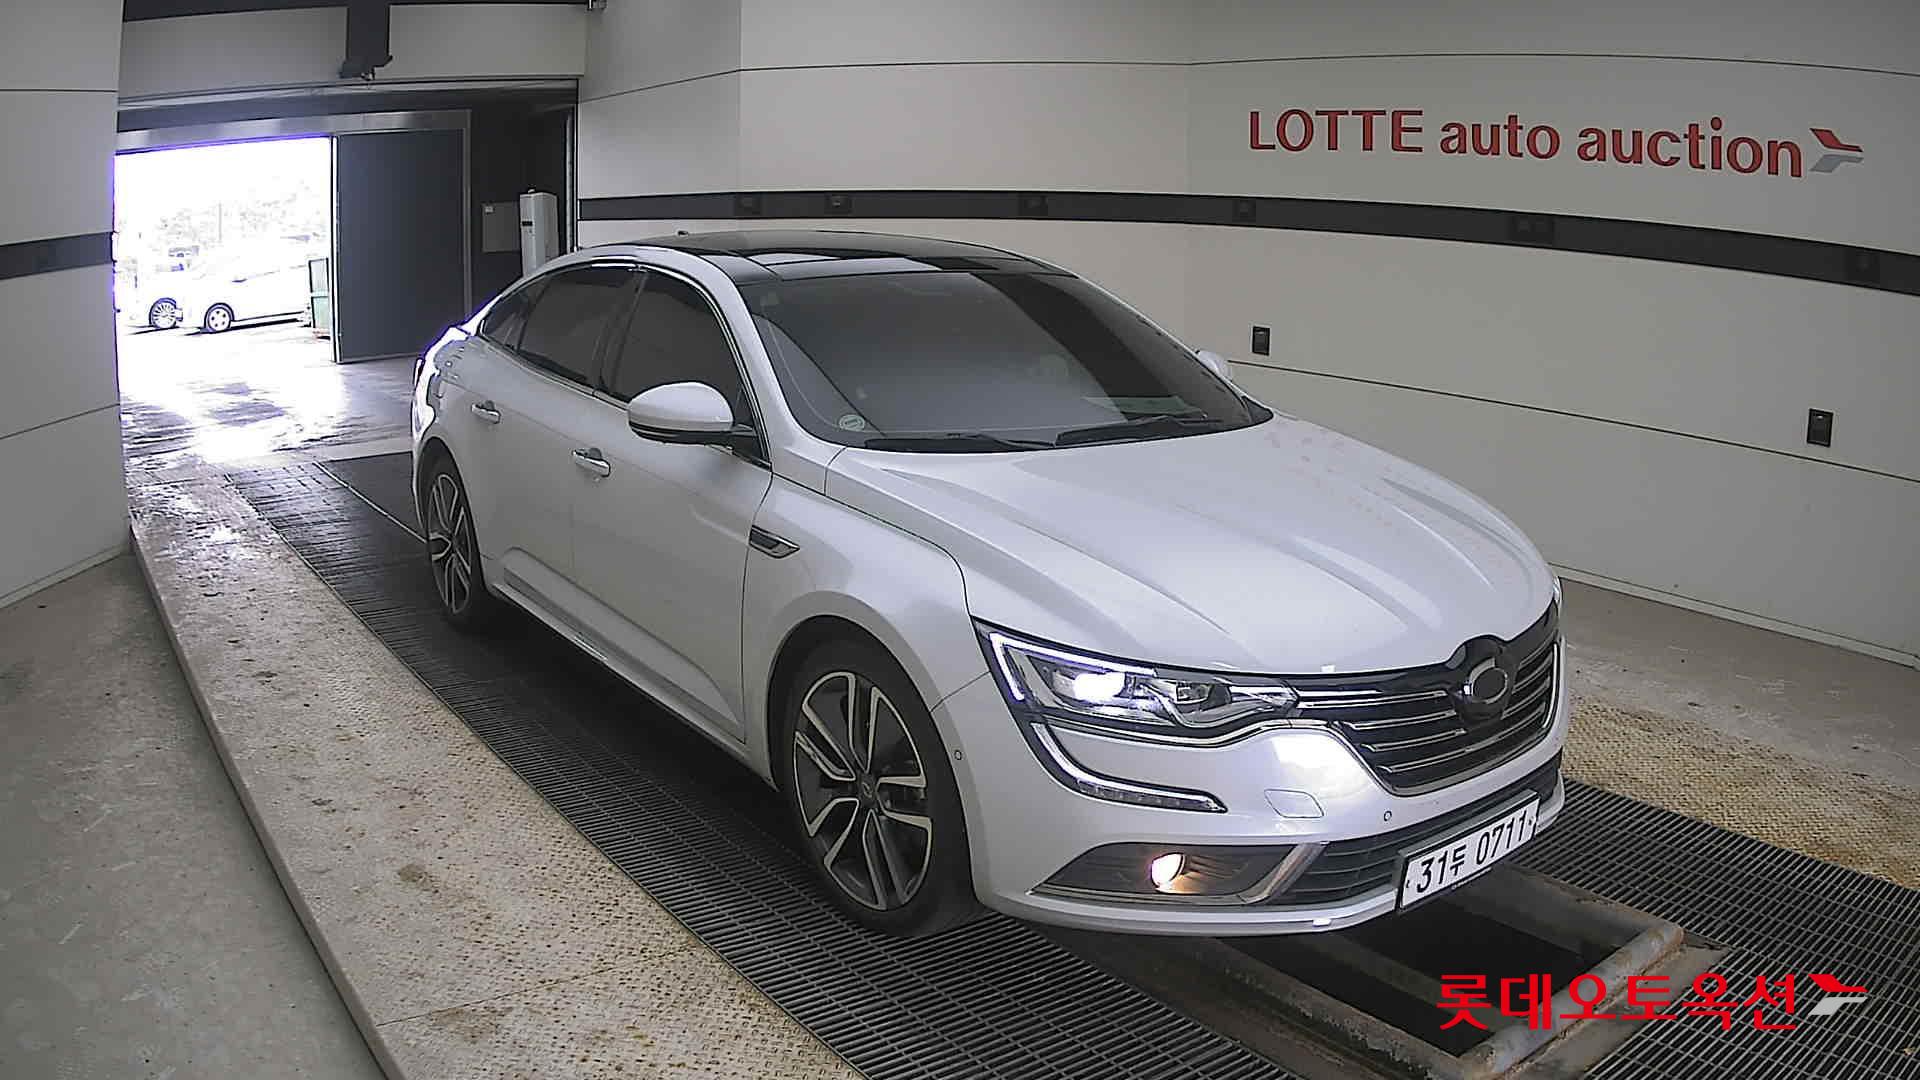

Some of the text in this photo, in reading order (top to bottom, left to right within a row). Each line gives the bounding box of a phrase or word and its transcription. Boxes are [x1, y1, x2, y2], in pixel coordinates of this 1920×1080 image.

[1249, 110, 1802, 178] LOTTE auto auction
[1417, 844, 1467, 893] 31두
[1476, 810, 1528, 866] 0711
